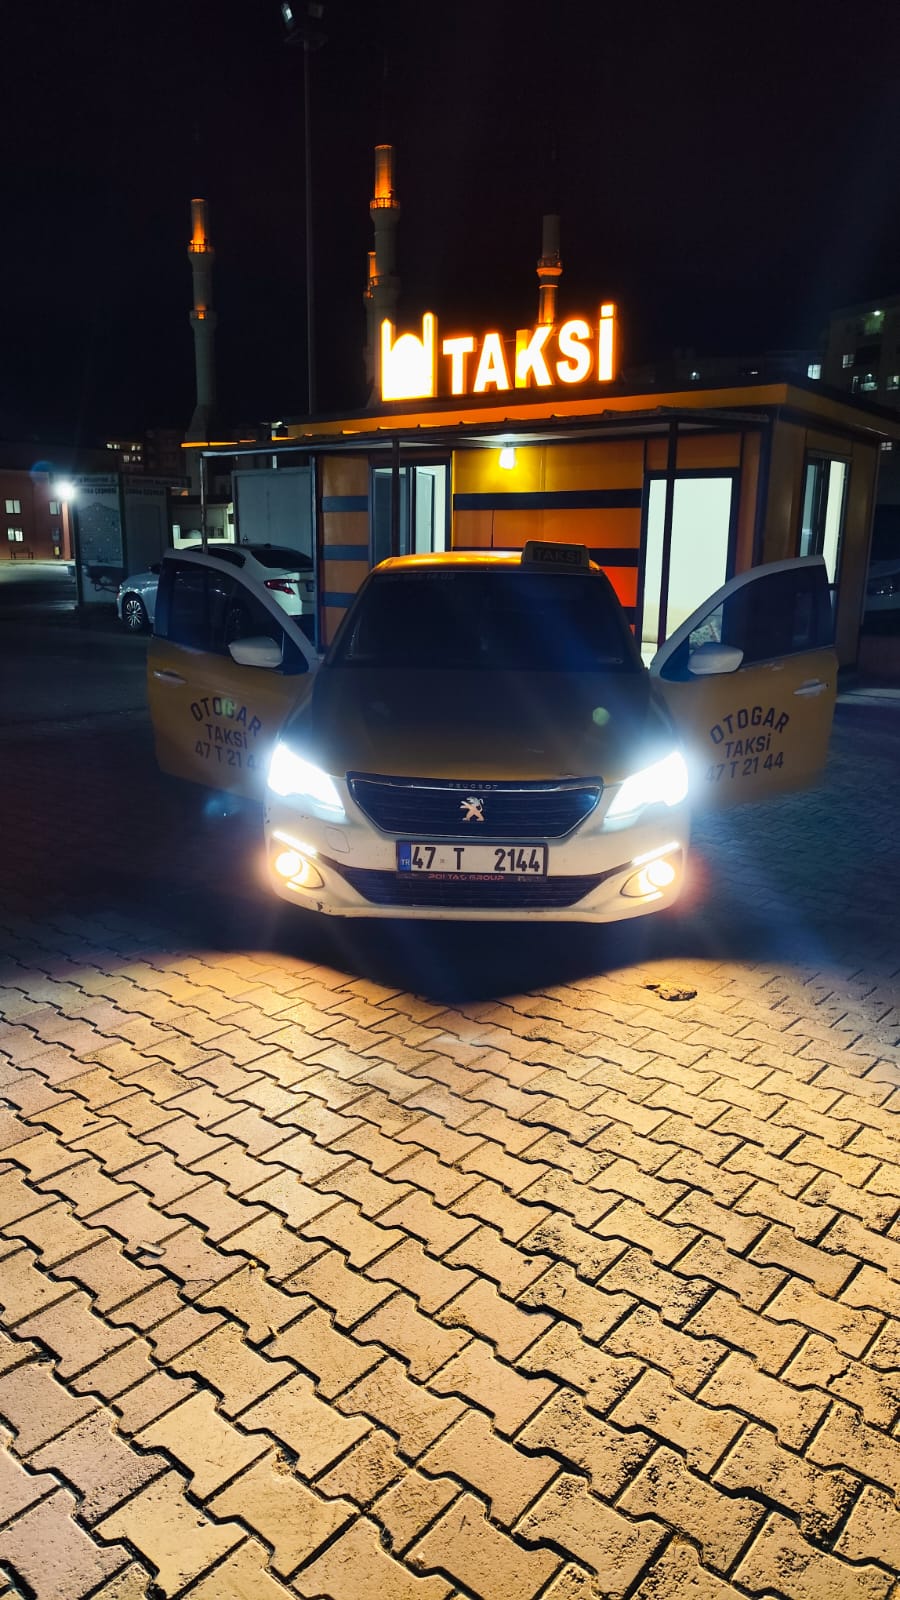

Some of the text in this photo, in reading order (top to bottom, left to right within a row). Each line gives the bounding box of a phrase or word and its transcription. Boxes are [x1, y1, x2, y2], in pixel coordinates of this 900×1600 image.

[442, 305, 615, 396] TAKSİ
[190, 696, 262, 736] OTOGAR
[710, 706, 790, 744] OTOGAR
[205, 723, 248, 749] TAKSİ
[725, 733, 771, 758] TAKSİ
[195, 741, 210, 759] 47
[214, 745, 222, 763] T
[730, 761, 738, 778] T
[412, 846, 540, 872] 47 T 2144
